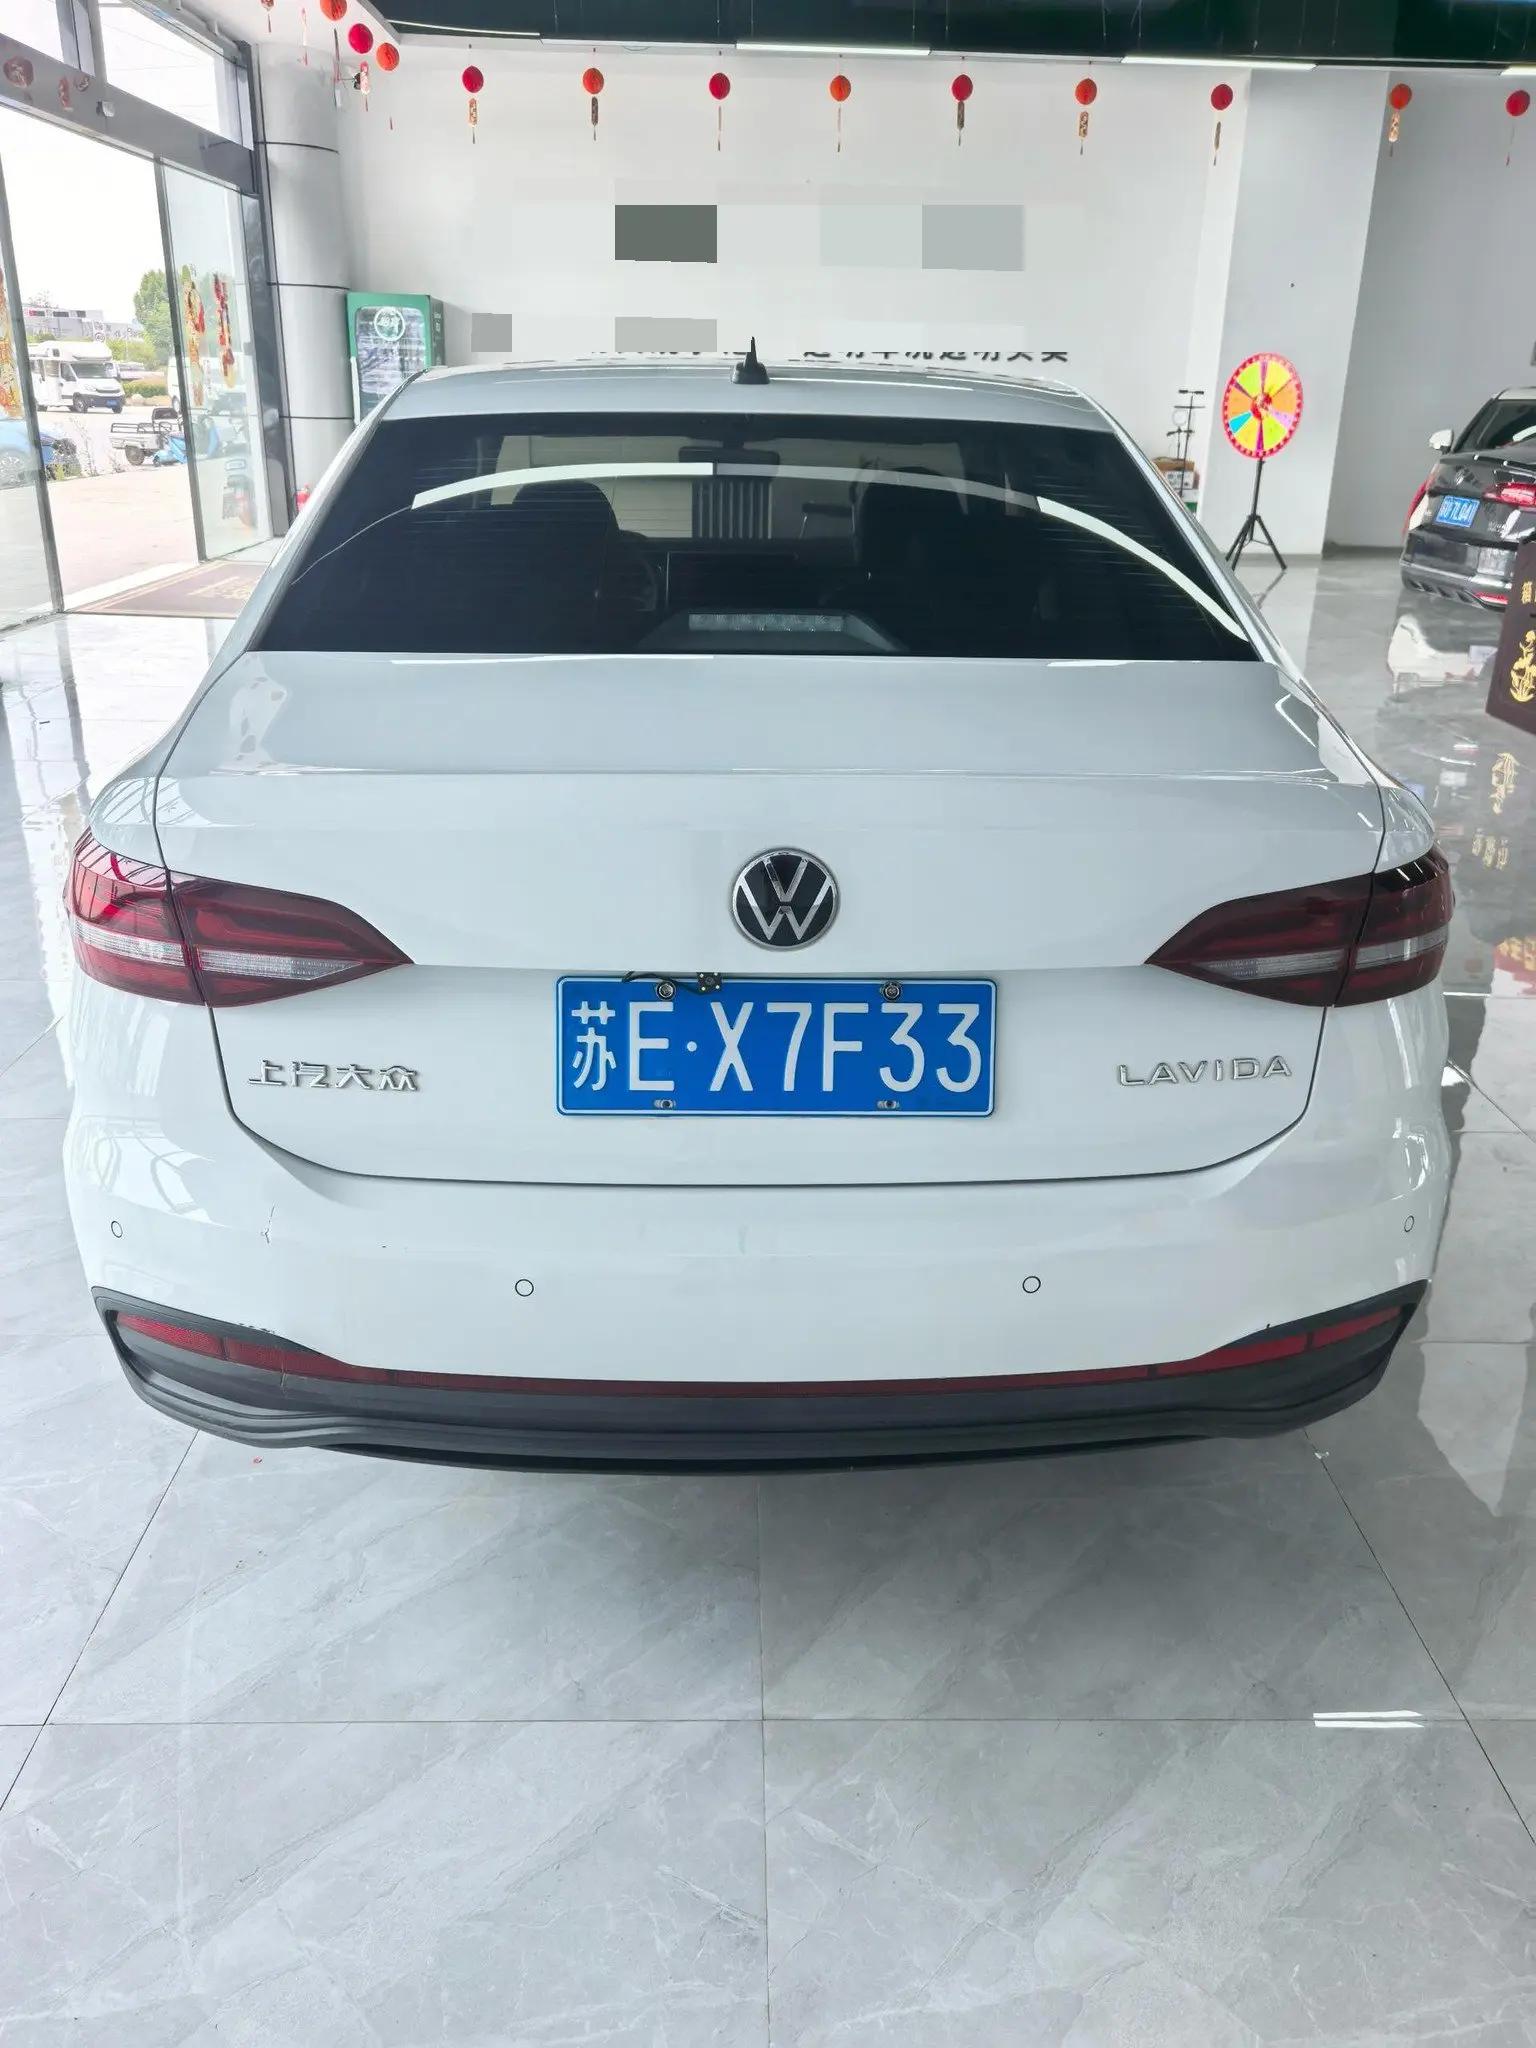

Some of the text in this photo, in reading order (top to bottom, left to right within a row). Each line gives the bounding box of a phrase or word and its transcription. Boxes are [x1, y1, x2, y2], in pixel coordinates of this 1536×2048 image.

[247, 1059, 418, 1091] 上汽大众
[1117, 1055, 1292, 1086] LAVIDA
